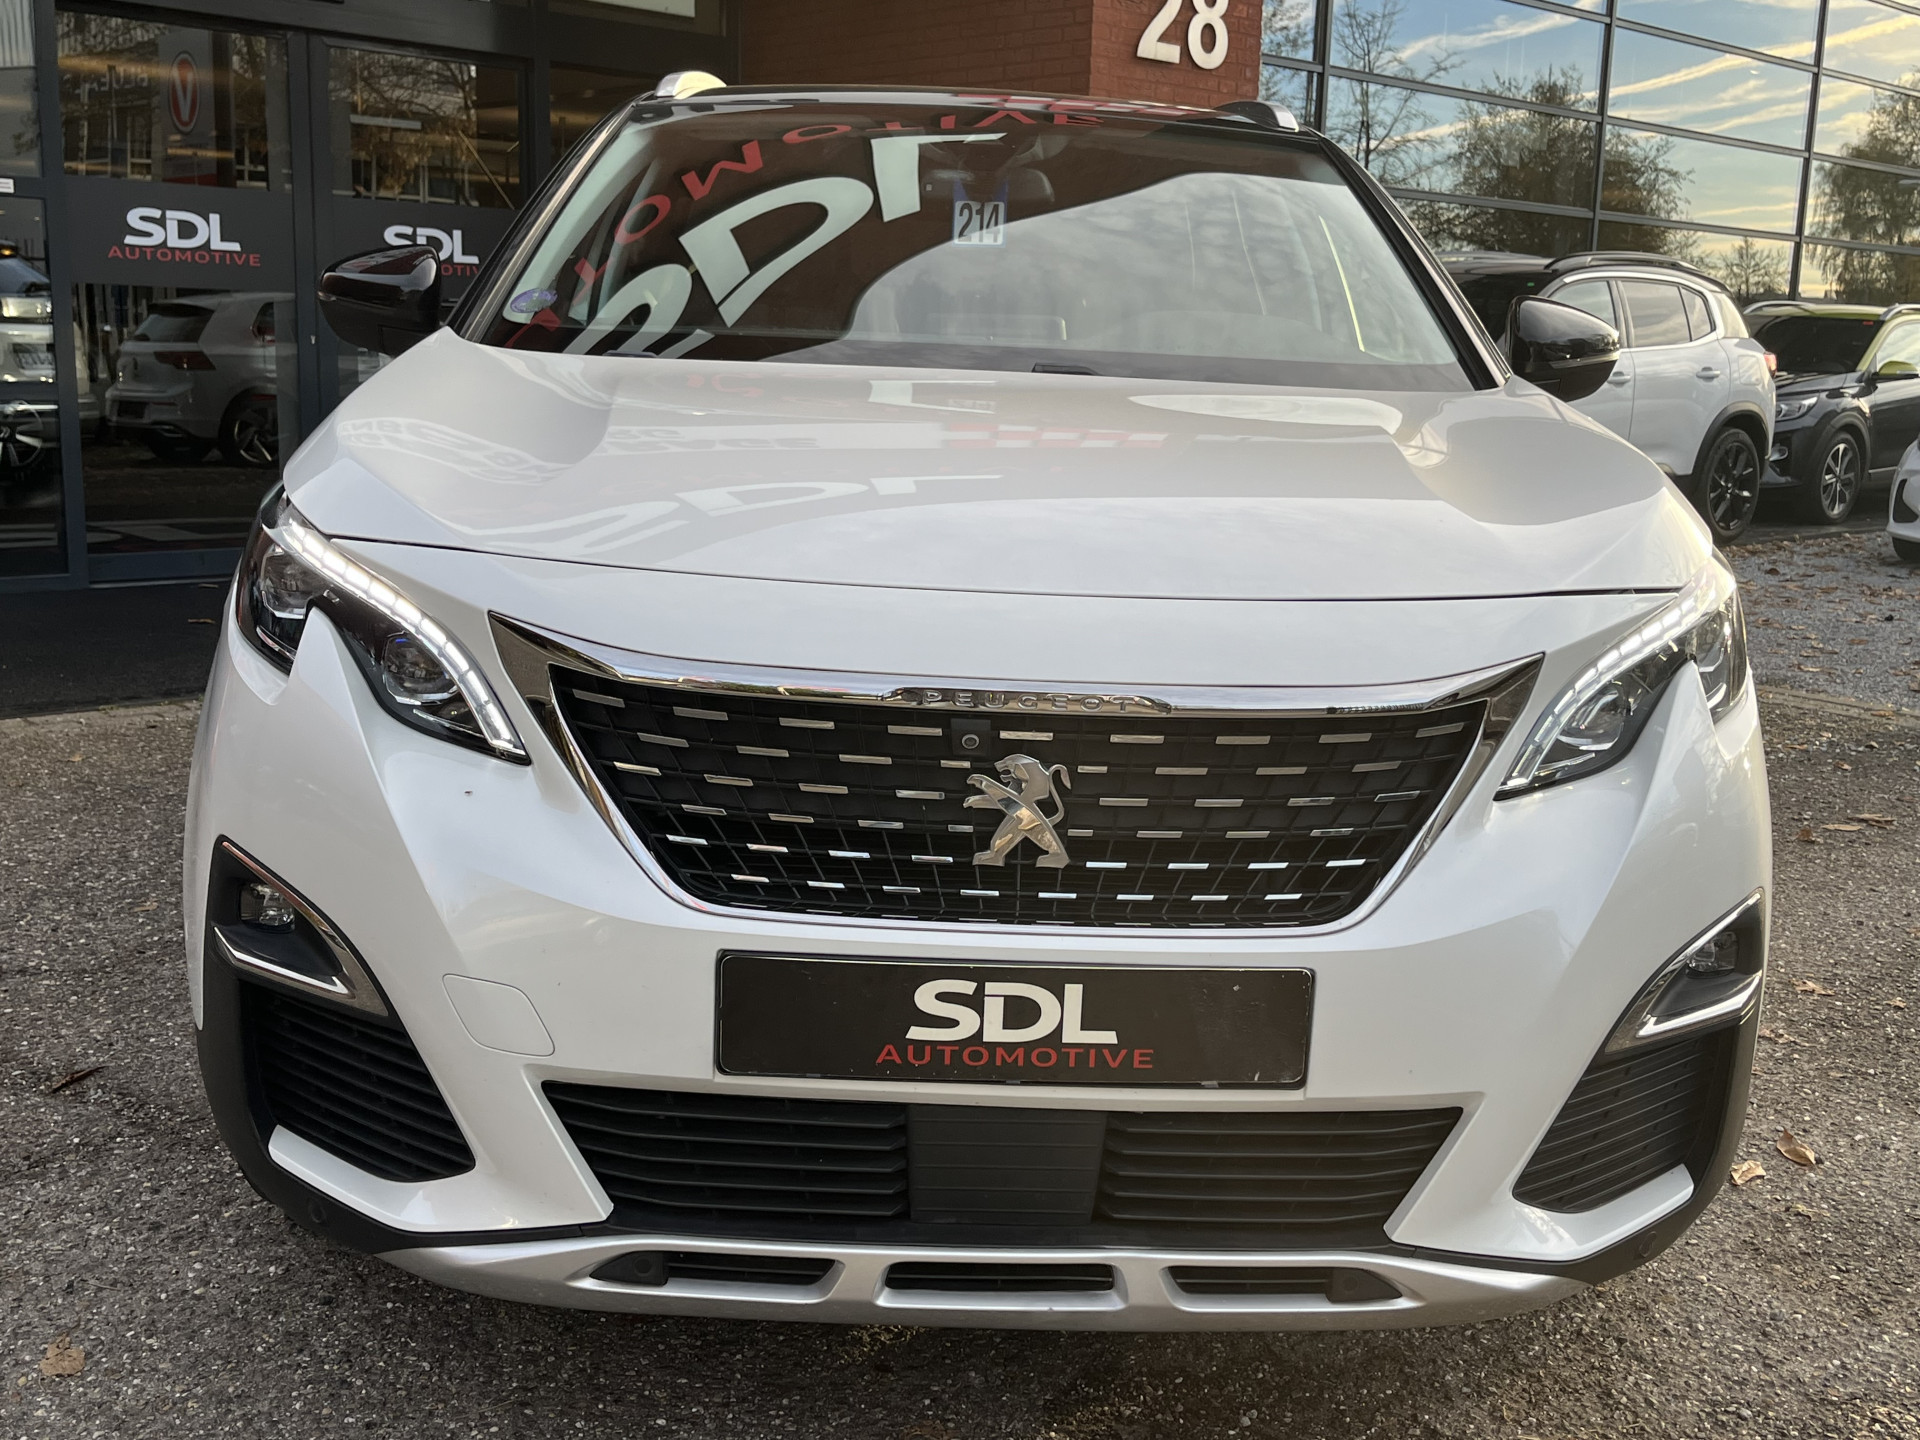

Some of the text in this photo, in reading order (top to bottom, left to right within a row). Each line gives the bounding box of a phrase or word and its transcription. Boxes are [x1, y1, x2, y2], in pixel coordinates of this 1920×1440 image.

[1136, 0, 1229, 70] 28
[123, 206, 242, 252] SDL
[957, 201, 1001, 243] 214
[107, 245, 261, 267] AUTOMOTIVE
[383, 224, 480, 265] SDL
[923, 690, 1134, 713] PEUGEOT
[905, 979, 1118, 1044] SDL
[875, 1044, 1154, 1069] AUTOMOTIVE
